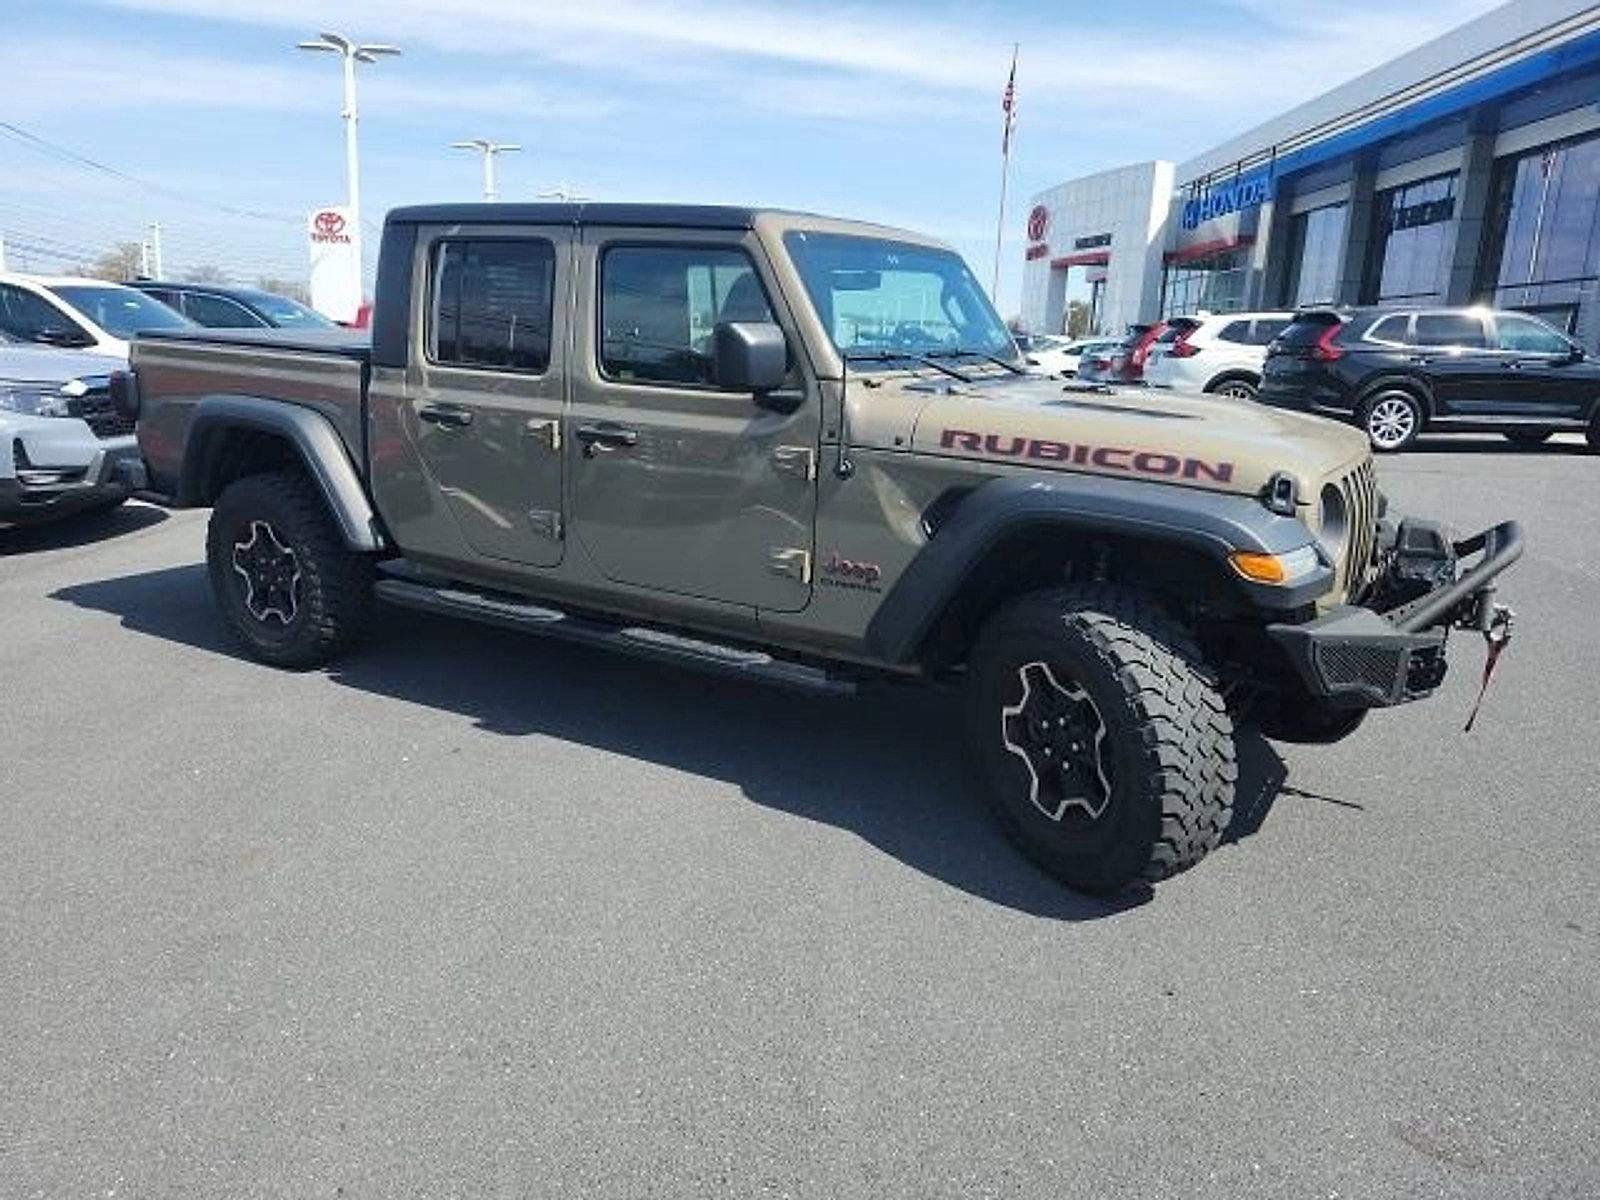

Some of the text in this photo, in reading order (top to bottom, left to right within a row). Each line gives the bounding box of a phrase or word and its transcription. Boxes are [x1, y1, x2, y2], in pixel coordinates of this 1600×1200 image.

[1201, 179, 1271, 221] HONDA
[311, 233, 351, 243] TOYOTA
[940, 428, 1233, 483] RUBICON
[822, 553, 880, 582] Jeep
